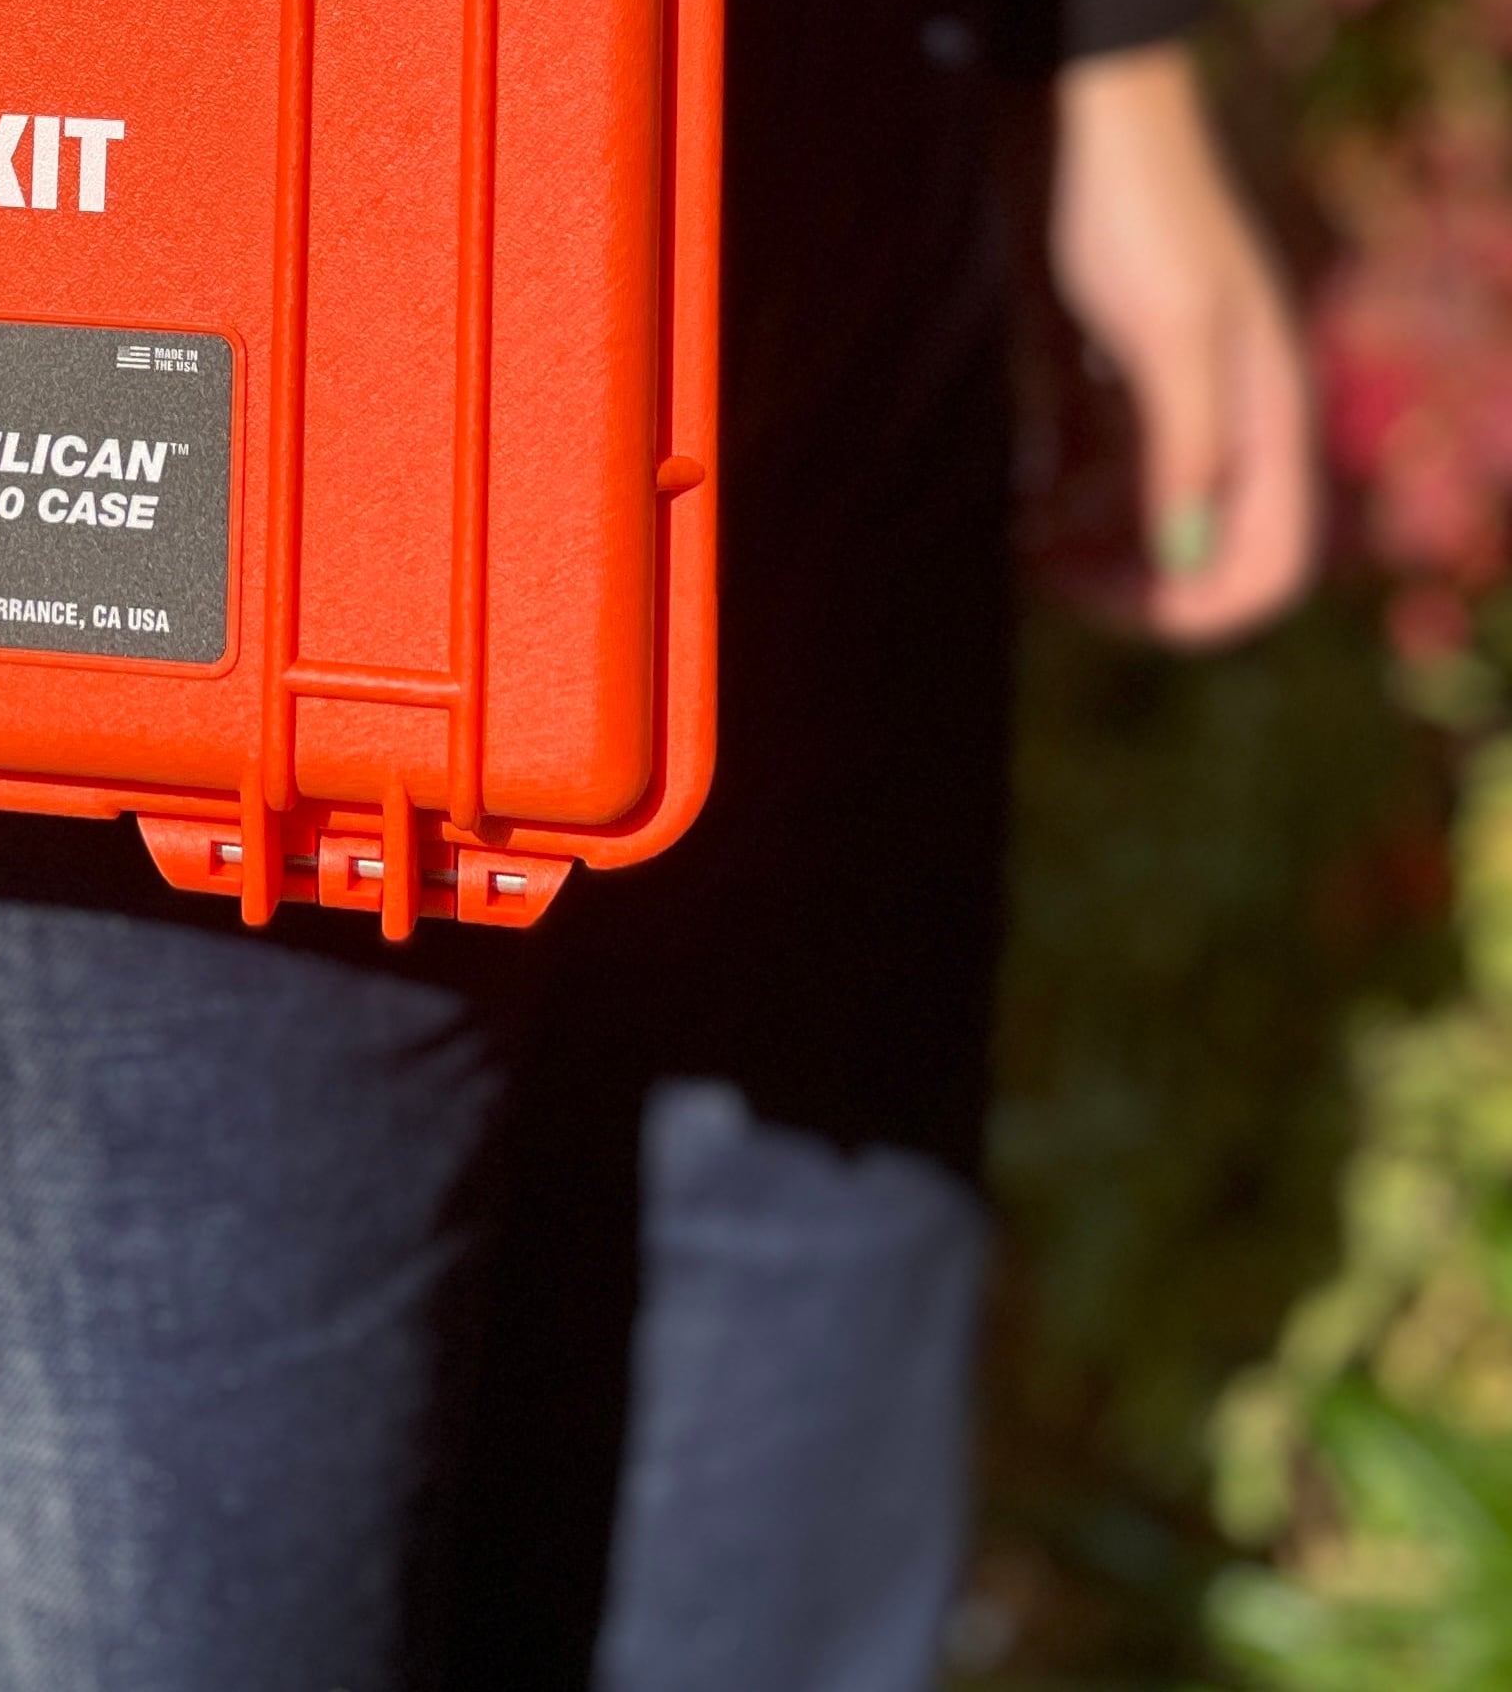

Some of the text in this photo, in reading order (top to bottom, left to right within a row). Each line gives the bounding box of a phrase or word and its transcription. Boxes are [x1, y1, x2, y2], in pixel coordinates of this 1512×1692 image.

[154, 347, 198, 361] MADE IN
[154, 359, 198, 373] THE USA
[38, 488, 160, 530] CASE
[92, 604, 122, 629] CA
[127, 607, 170, 633] USA
